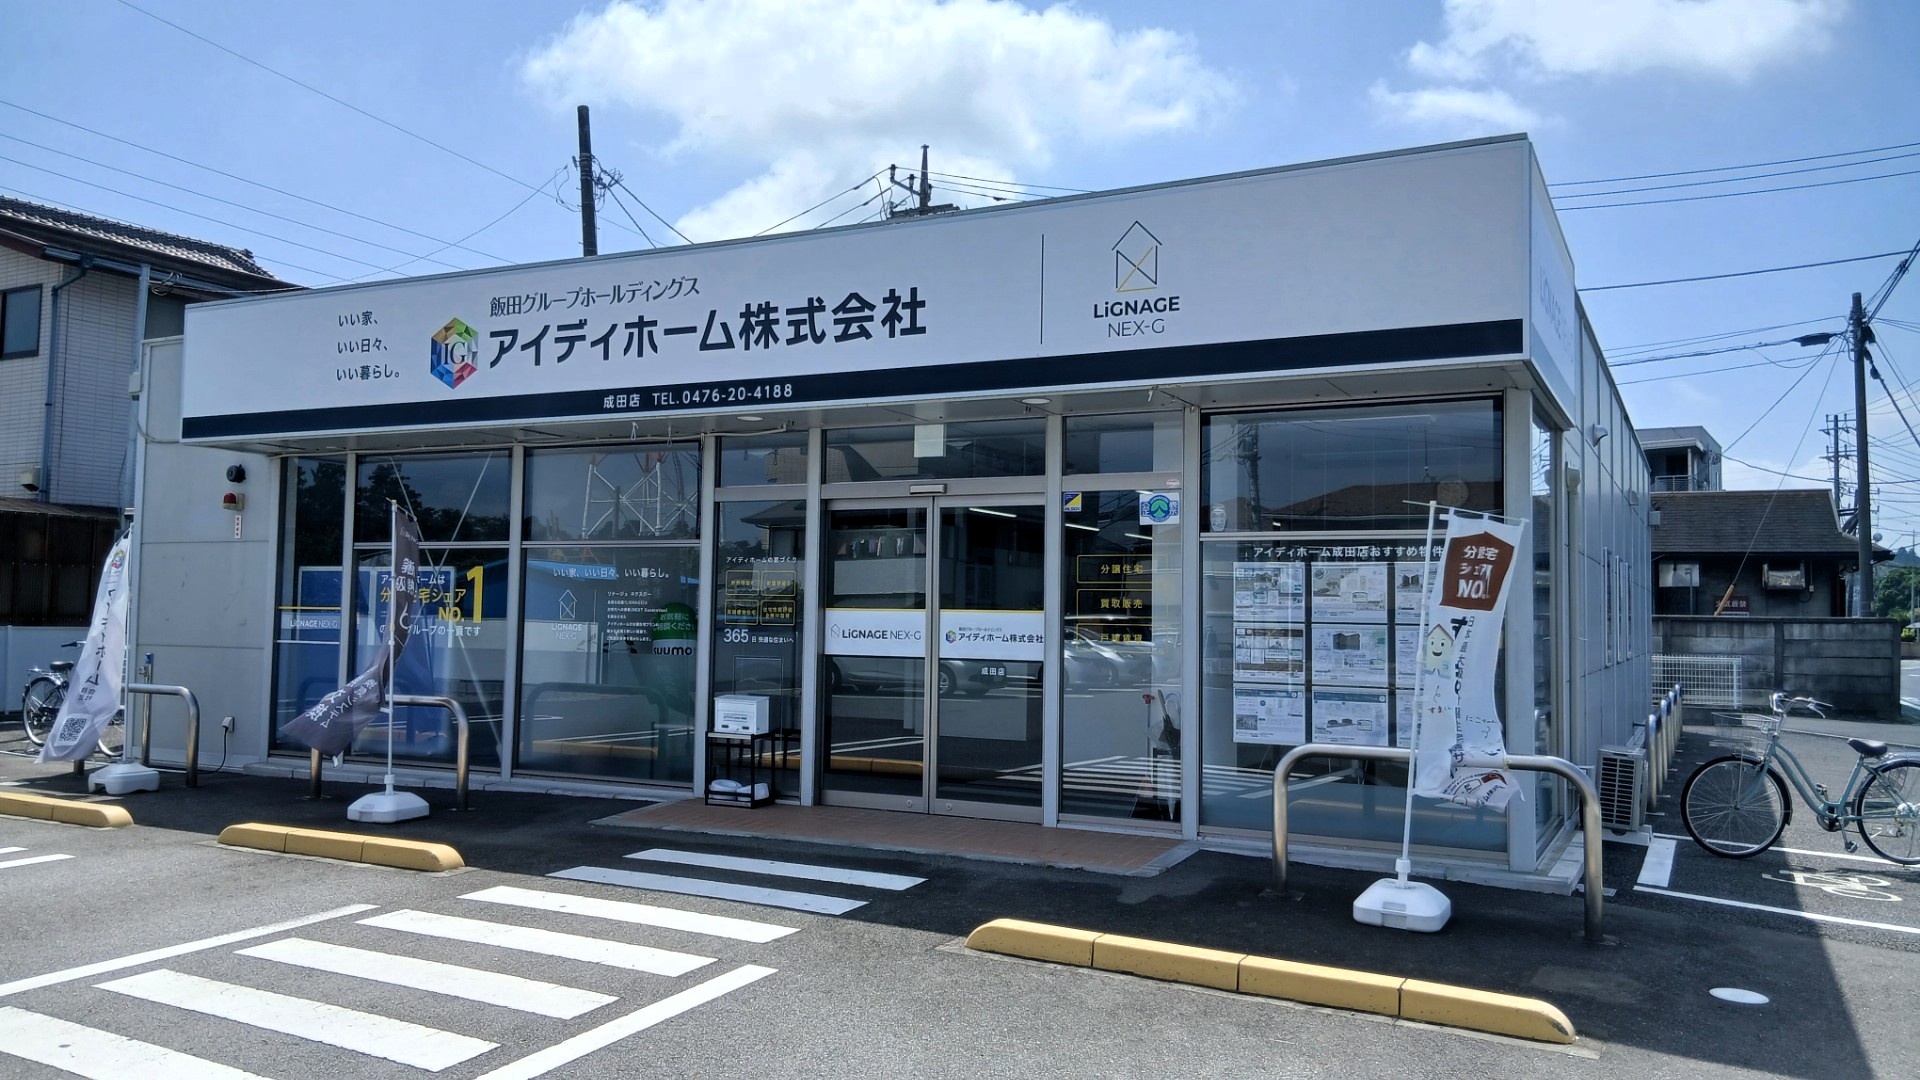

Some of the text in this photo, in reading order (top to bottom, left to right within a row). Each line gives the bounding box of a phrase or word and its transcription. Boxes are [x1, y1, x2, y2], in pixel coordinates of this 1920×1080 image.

[489, 276, 701, 318] 飯田グループホールディングス
[1093, 296, 1180, 318] LiGNAGE
[489, 286, 927, 369] アイディホーム株式会社
[1108, 318, 1165, 338] NEX-G
[603, 393, 641, 409] 成田店
[889, 630, 922, 640] NEX-G
[958, 633, 1045, 643] アイディホーム株式会社
[981, 667, 1006, 676] 成田店
